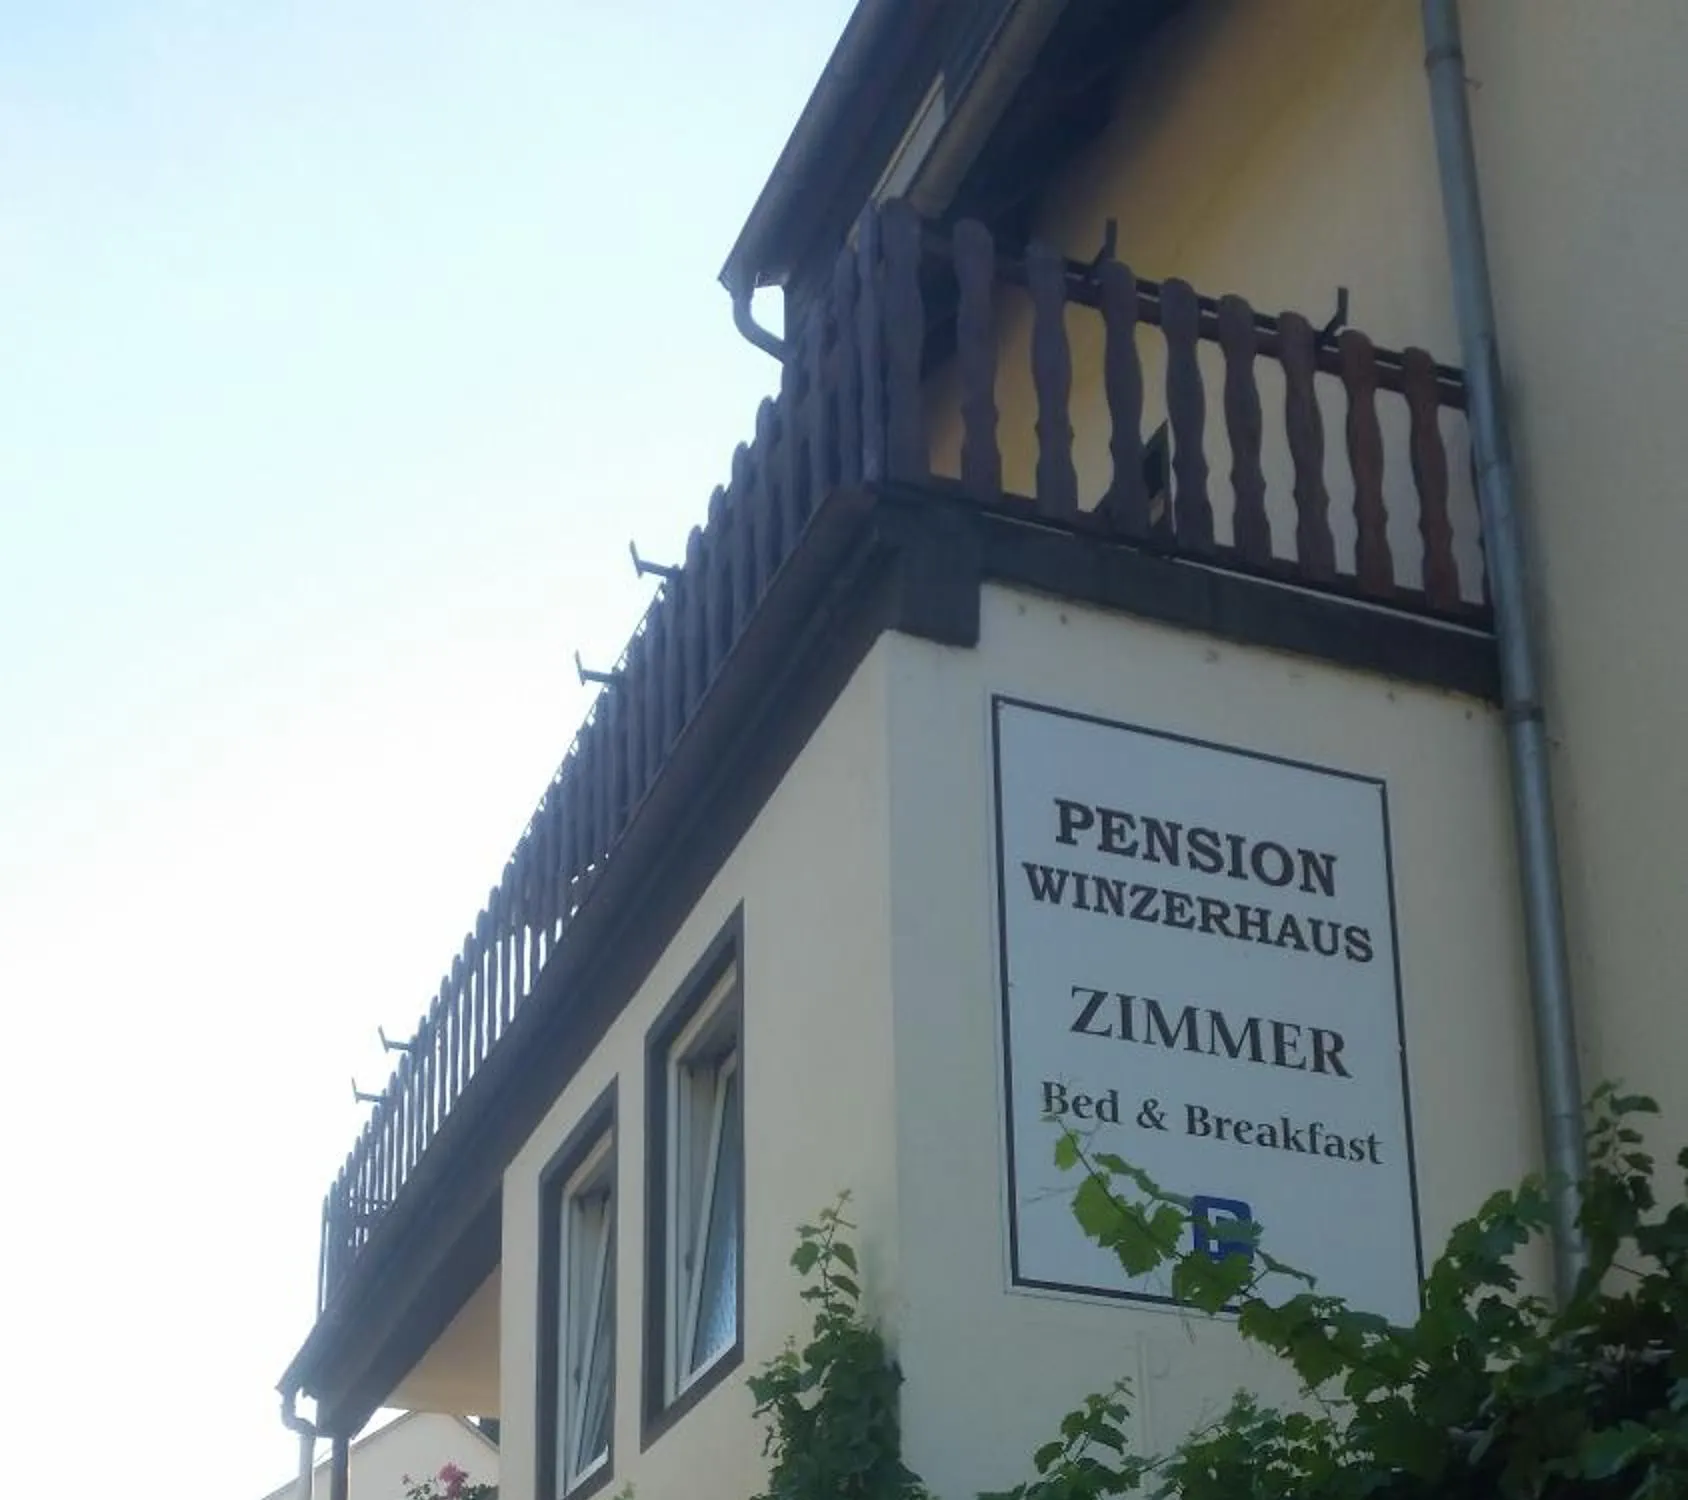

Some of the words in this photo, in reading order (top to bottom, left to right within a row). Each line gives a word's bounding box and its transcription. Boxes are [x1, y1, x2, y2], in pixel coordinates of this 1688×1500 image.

[1054, 798, 1338, 897] PENSION
[1021, 862, 1375, 963] WINZERHAUS
[1070, 985, 1353, 1079] ZIMMER
[1041, 1080, 1120, 1124] Bed
[1136, 1098, 1168, 1132] &
[1185, 1103, 1384, 1165] Breakfast
